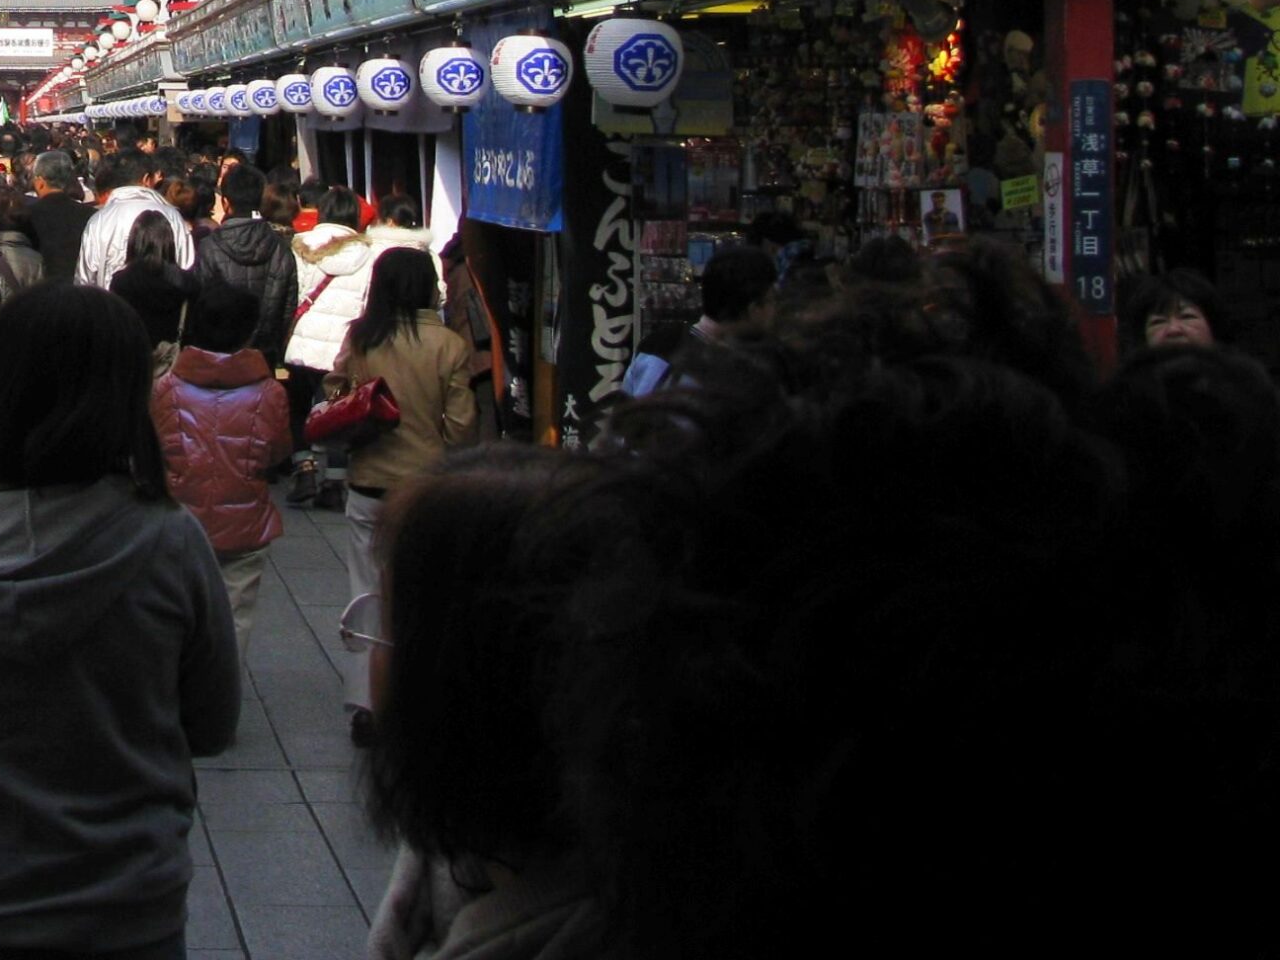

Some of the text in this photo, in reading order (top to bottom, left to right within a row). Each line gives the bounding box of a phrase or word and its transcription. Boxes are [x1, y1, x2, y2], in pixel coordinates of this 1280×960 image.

[1081, 132, 1100, 256] 浅草一丁目
[1076, 275, 1106, 301] 18
